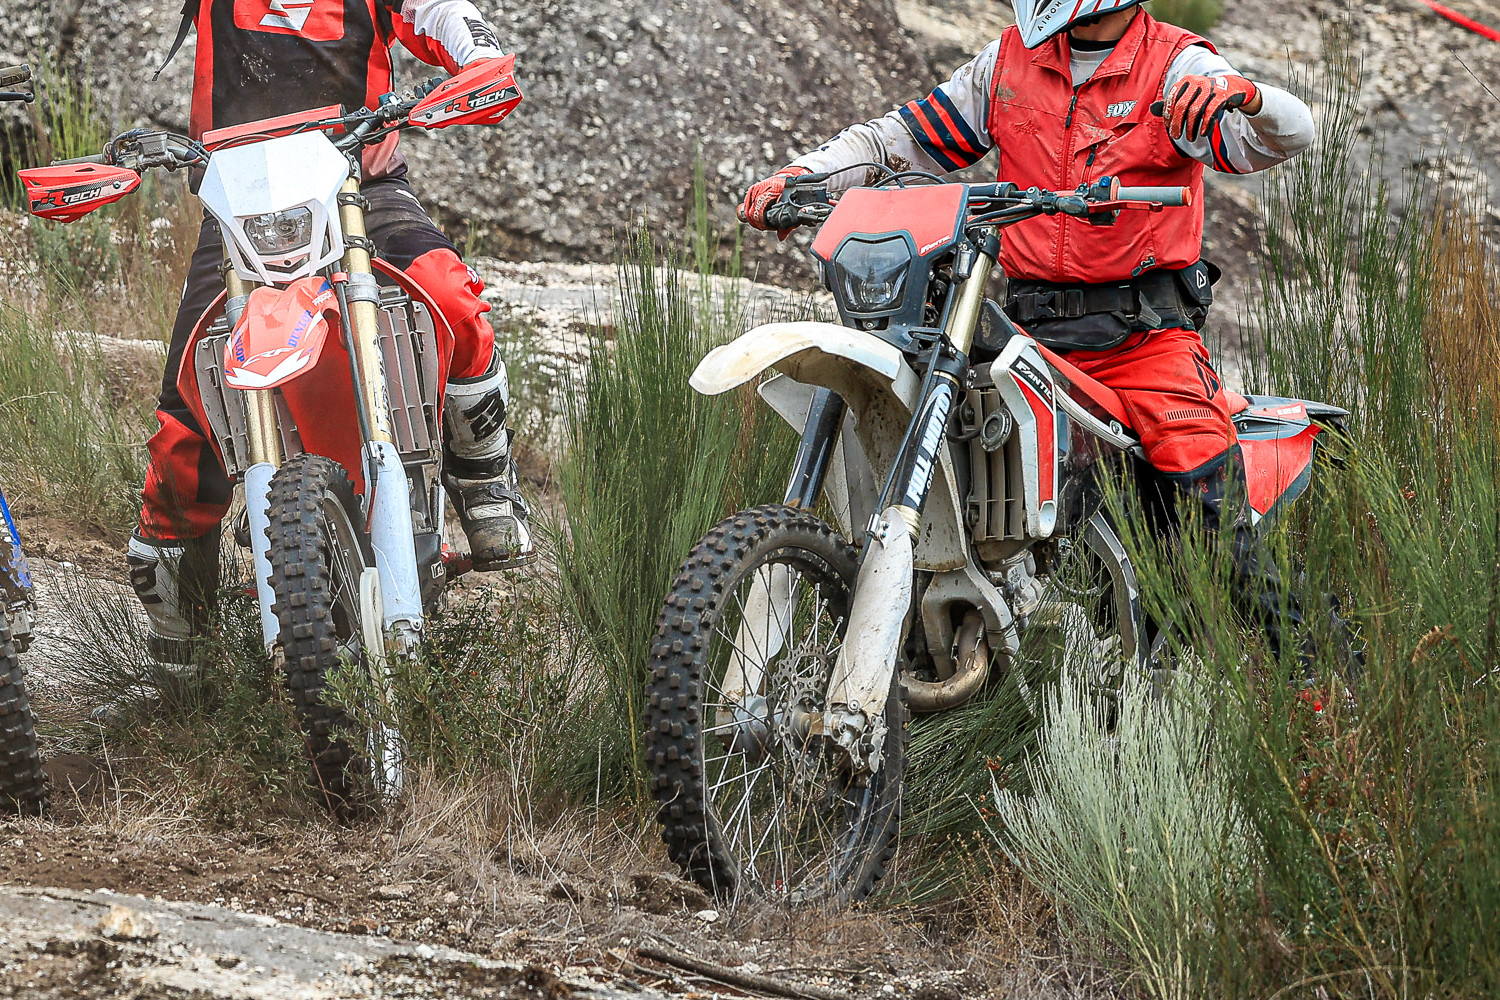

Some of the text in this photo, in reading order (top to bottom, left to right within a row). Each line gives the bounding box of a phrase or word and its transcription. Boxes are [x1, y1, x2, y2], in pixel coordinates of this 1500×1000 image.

[1036, 0, 1063, 32] AIROH
[1015, 360, 1054, 401] FANTIC
[906, 393, 951, 507] FULL MOTO
